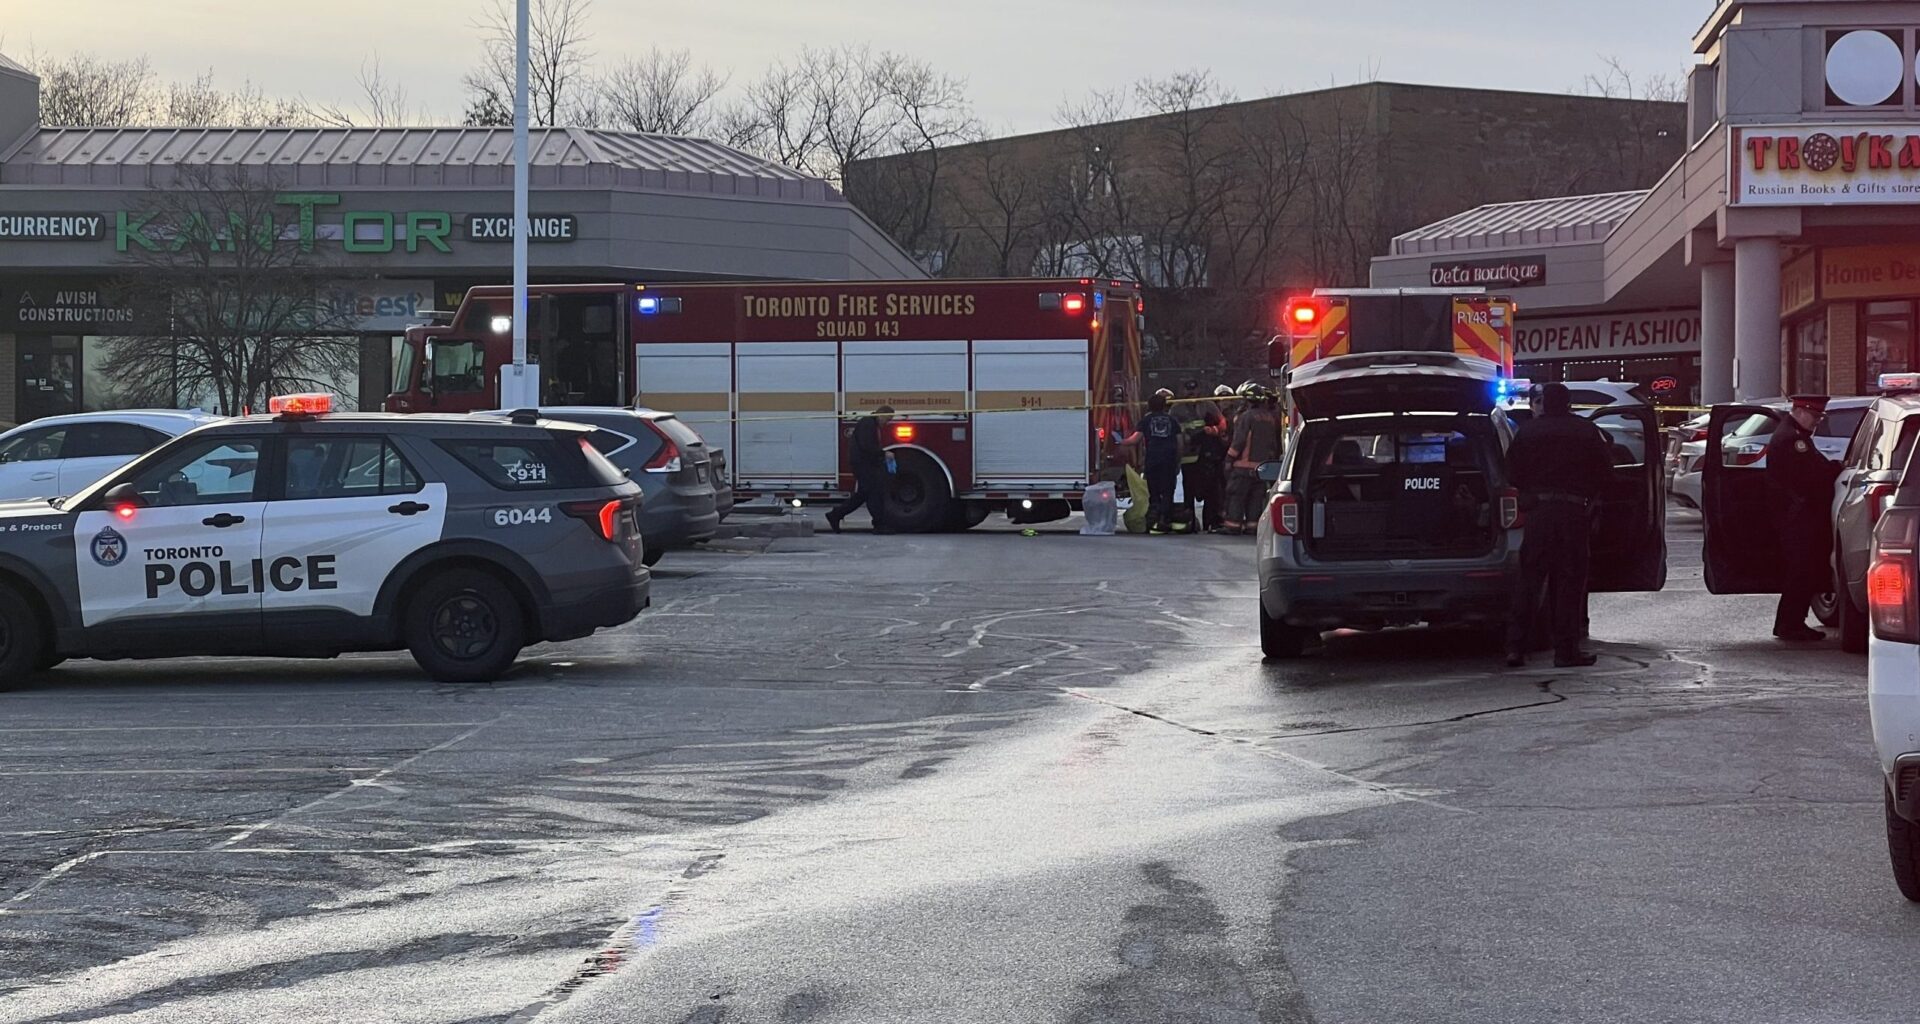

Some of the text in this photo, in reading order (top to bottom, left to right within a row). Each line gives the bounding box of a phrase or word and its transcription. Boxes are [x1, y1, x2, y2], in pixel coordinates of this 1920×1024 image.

[1749, 182, 1920, 195] Russian Books & Gifts store
[0, 216, 99, 236] CURRENCY
[116, 194, 453, 253] KANTOR
[1432, 265, 1469, 285] Veta
[1825, 260, 1920, 285] Home De
[56, 291, 97, 305] AVISH
[744, 293, 975, 317] TORONTO FIRE SERVICES
[19, 307, 134, 322] CONSTRUCTIONS
[1457, 311, 1488, 324] P143
[817, 320, 899, 337] SQUAD 143
[1513, 325, 1600, 355] ROPEAN
[1651, 379, 1676, 390] OPEN
[1021, 396, 1041, 407] 9-1-1
[1404, 477, 1440, 490] POLICE
[494, 507, 552, 526] 6044
[9, 524, 18, 532] &
[21, 522, 62, 532] Protect
[144, 545, 223, 561] TORONTO
[145, 554, 338, 599] POLICE
